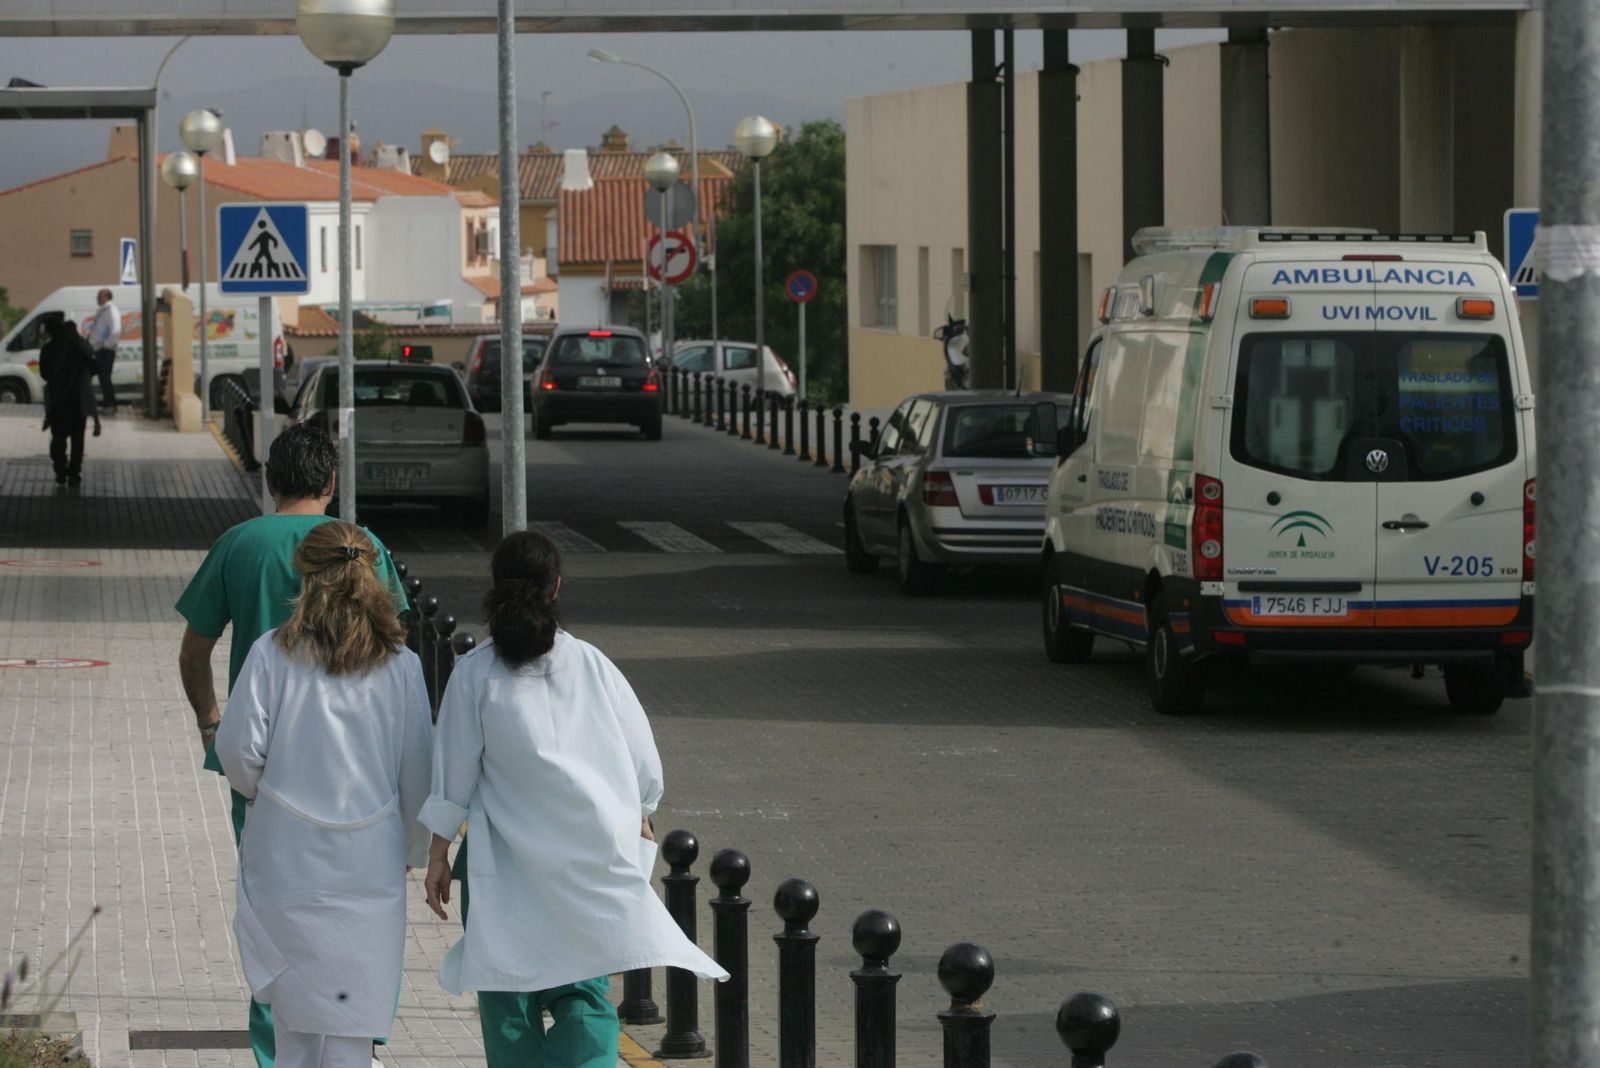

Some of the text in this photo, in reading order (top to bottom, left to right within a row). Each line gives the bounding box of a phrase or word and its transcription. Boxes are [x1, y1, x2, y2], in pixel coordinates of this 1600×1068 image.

[1272, 268, 1475, 286] AMBULANCIA
[1321, 306, 1437, 321] UVI MOVIL
[1400, 371, 1496, 384] TRASLADO DE
[1399, 394, 1500, 411] PACIENTES
[1400, 415, 1487, 433] CRITICOS
[1005, 487, 1037, 500] 0717
[1267, 550, 1288, 559] JUNTA
[1423, 556, 1494, 577] V-205
[1267, 597, 1342, 613] 7546 FJJ
